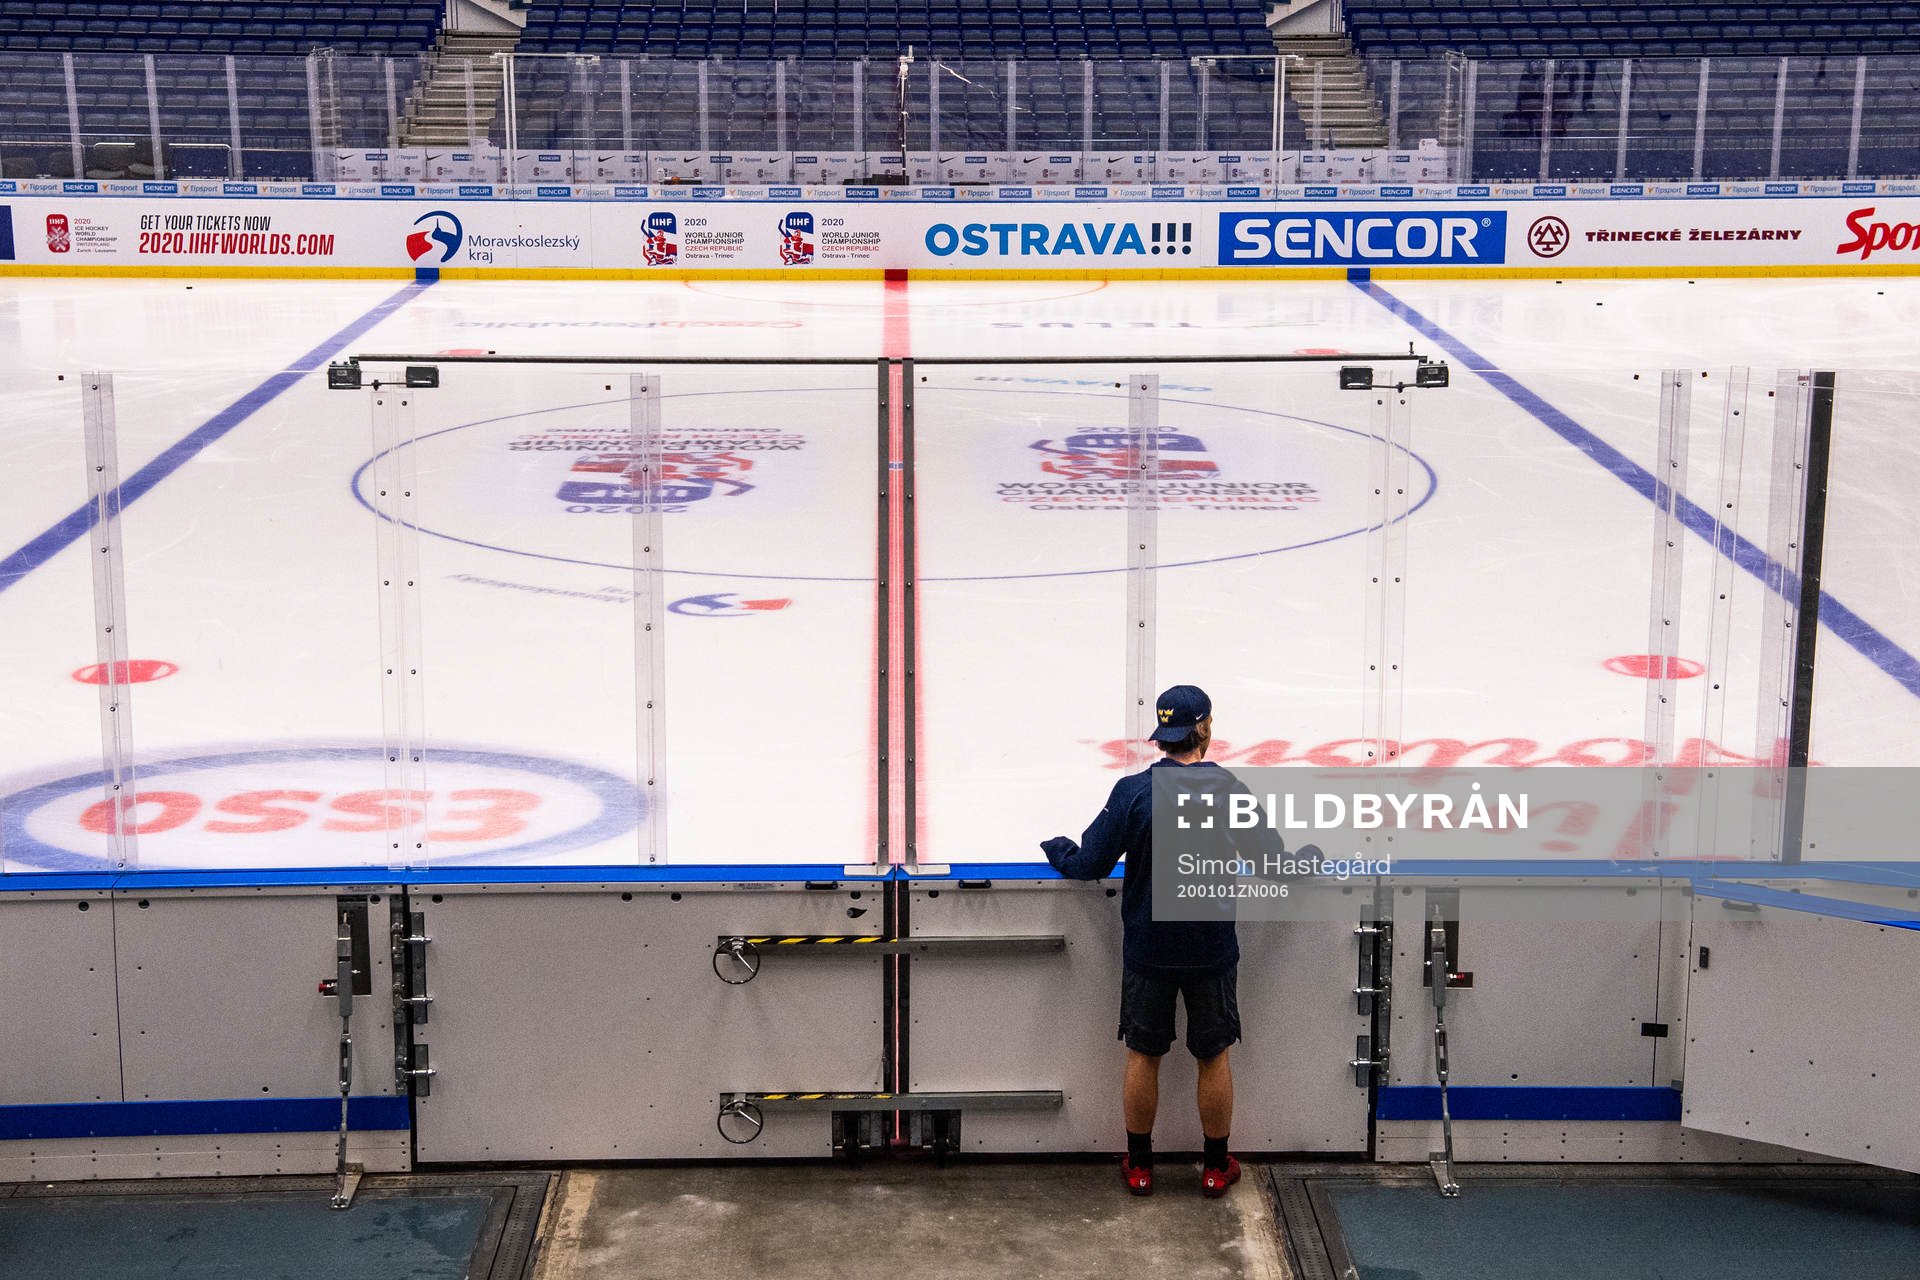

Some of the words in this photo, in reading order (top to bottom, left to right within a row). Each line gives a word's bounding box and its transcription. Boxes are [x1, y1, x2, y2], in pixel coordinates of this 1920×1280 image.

[30, 183, 57, 192] Tipsport
[110, 184, 137, 192] Tipsport
[190, 184, 218, 192] Tipsport
[269, 186, 296, 194] Tipsport
[737, 189, 764, 197] Tipsport
[814, 189, 840, 197] Tipsport
[891, 189, 917, 197] Tipsport
[967, 189, 993, 197] Tipsport
[1044, 189, 1070, 197] Tipsport
[1120, 189, 1146, 197] Tipsport
[1502, 187, 1528, 195] Tipsport
[1655, 186, 1682, 194] Tipsport
[1888, 184, 1916, 192] Tipsport
[140, 215, 160, 230] GET
[164, 215, 193, 230] YOUR
[196, 215, 240, 231] TICKETS
[244, 216, 271, 231] NOW
[652, 218, 672, 226] IIHF
[684, 218, 707, 226] 2020
[790, 218, 809, 226] IIHF
[822, 218, 844, 226] 2020
[925, 223, 1192, 256] OSTRAVA!!!
[1234, 218, 1478, 258] SENCOR
[1586, 229, 1682, 241] TŘINECKÉ
[1688, 228, 1802, 240] ŽELEZÁRNY
[139, 232, 334, 256] 2020.IIHFWORLDS.COM
[468, 234, 580, 250] Moravskoslezský
[468, 248, 493, 264] kraj
[565, 505, 688, 514] 2020
